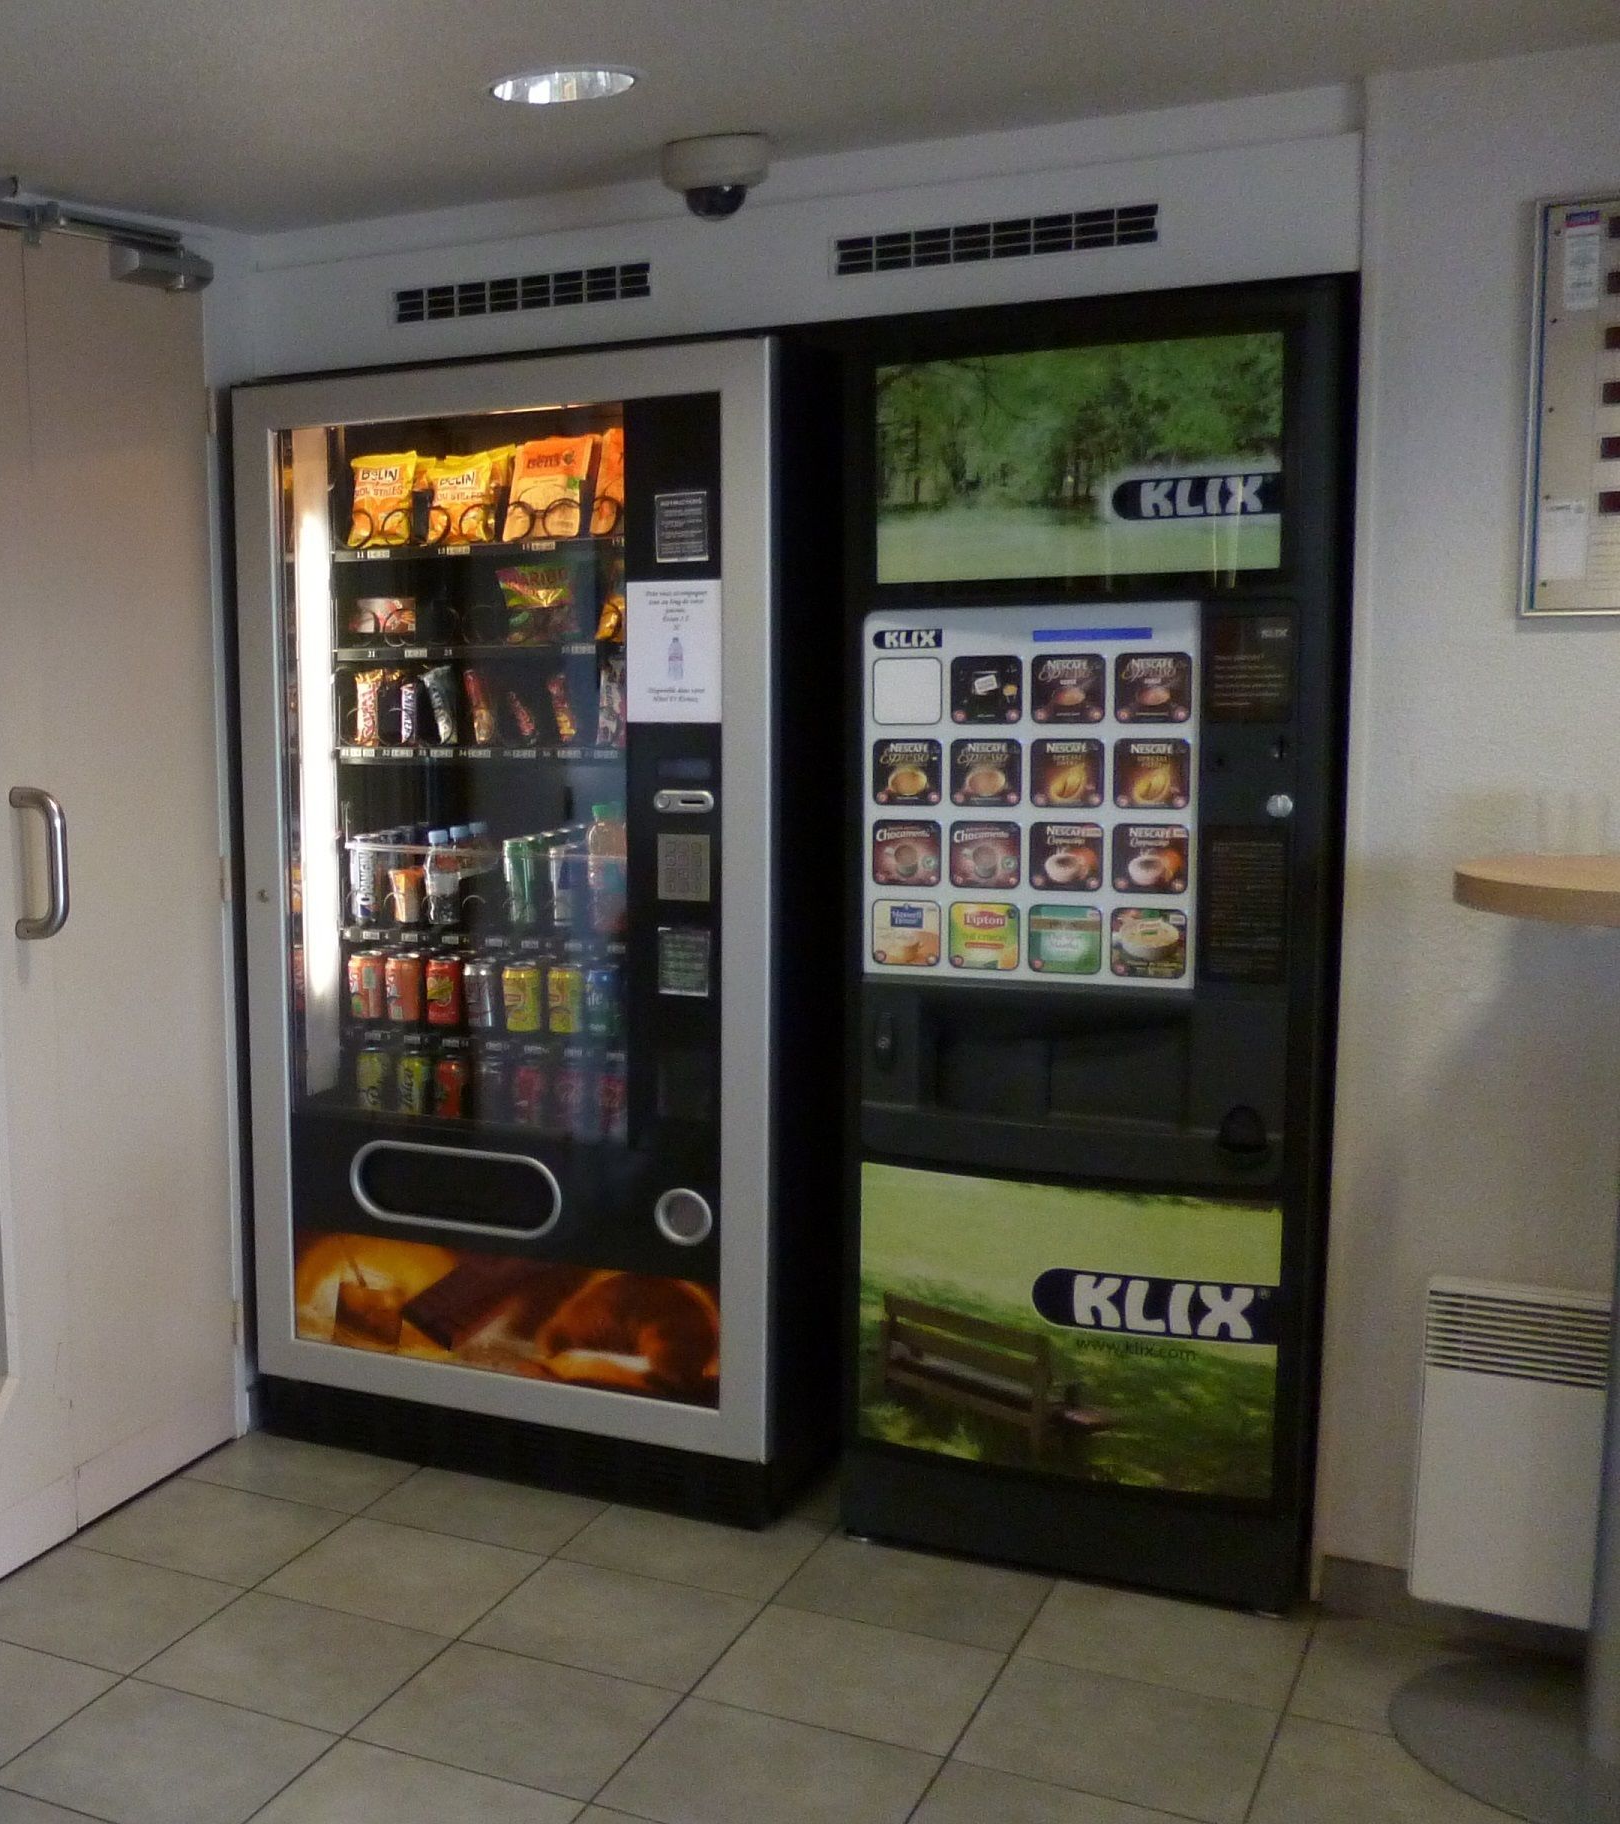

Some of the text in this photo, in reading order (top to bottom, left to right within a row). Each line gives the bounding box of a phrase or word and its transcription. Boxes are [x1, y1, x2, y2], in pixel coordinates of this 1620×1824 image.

[1140, 475, 1263, 518] KLIX
[884, 630, 936, 648] KLIX
[965, 914, 1004, 926] Lipton
[1073, 1274, 1254, 1340] KLIX
[1076, 1337, 1196, 1362] www.klix.com
